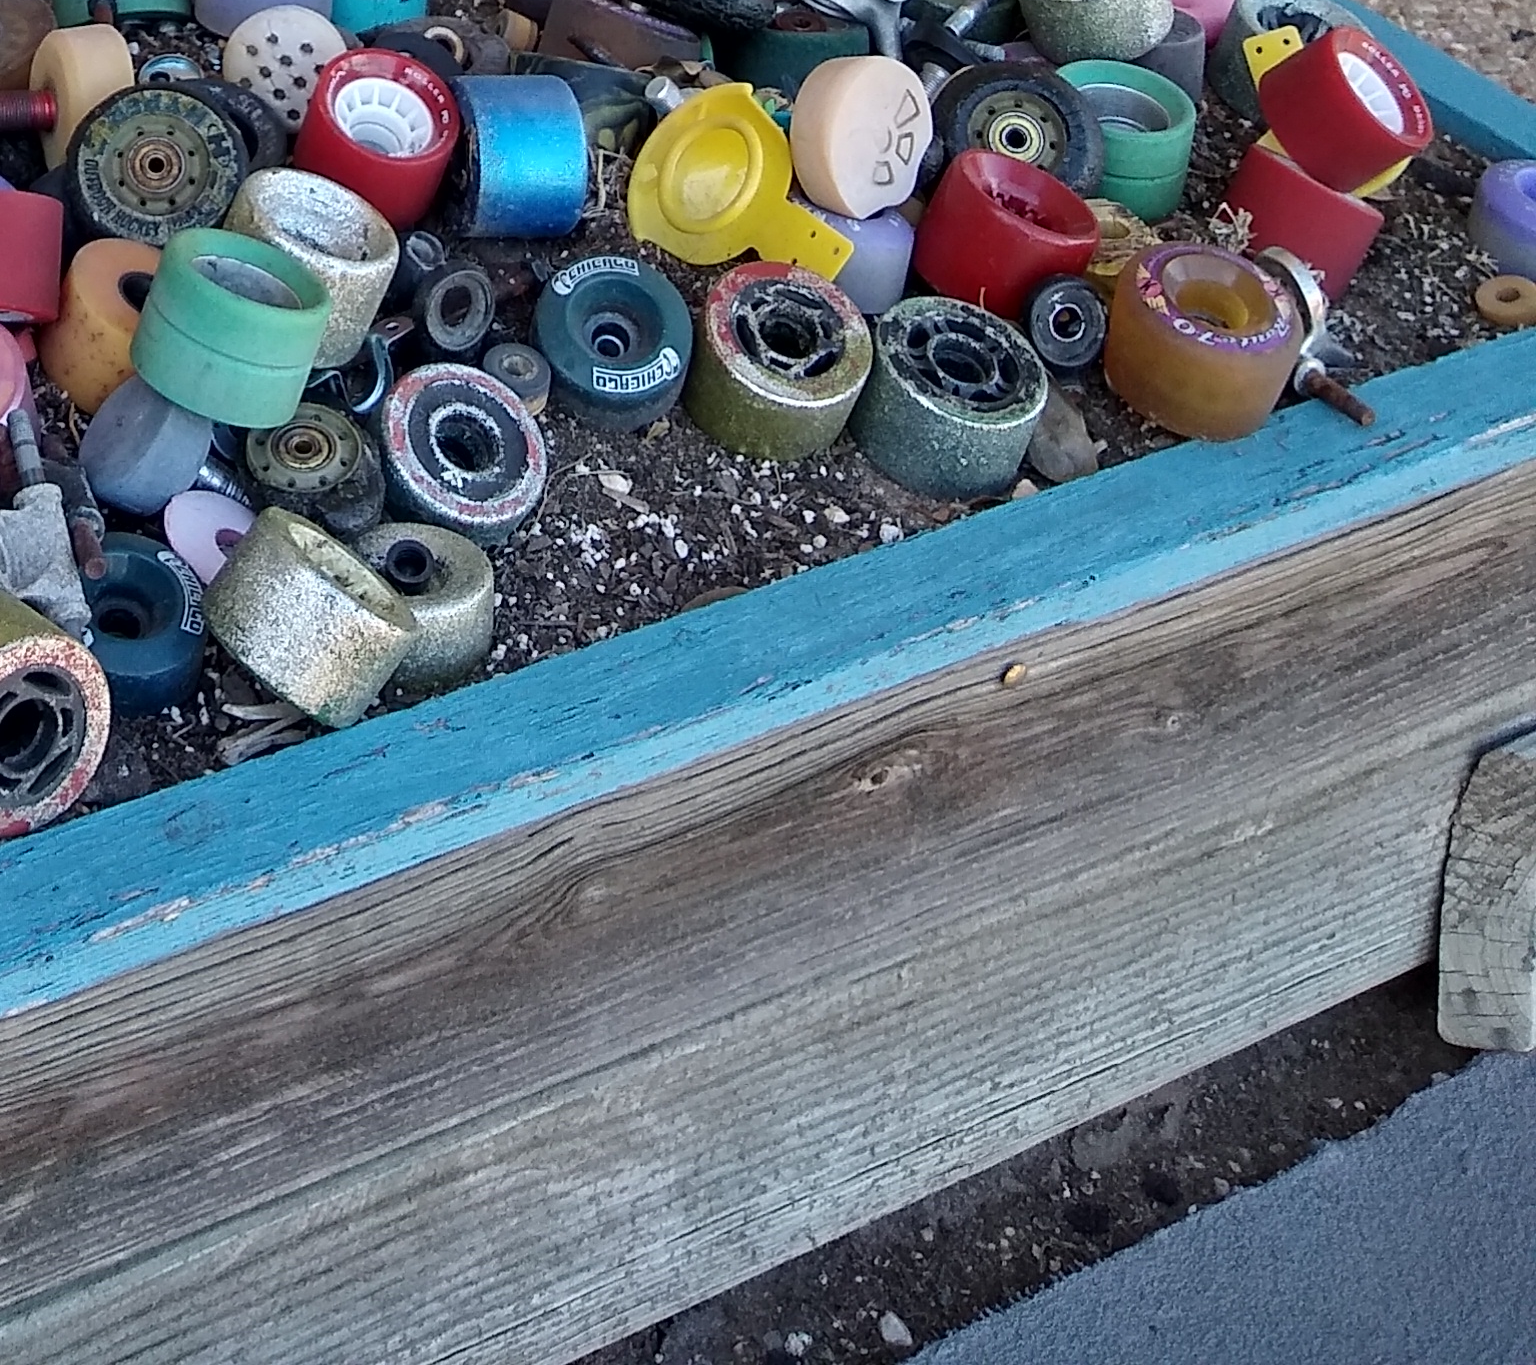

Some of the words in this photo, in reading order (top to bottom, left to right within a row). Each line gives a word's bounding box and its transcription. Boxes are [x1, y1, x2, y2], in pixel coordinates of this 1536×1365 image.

[403, 66, 447, 105] ROLLER
[82, 158, 116, 216] OUTDOOR
[115, 210, 162, 237] HOCKEY
